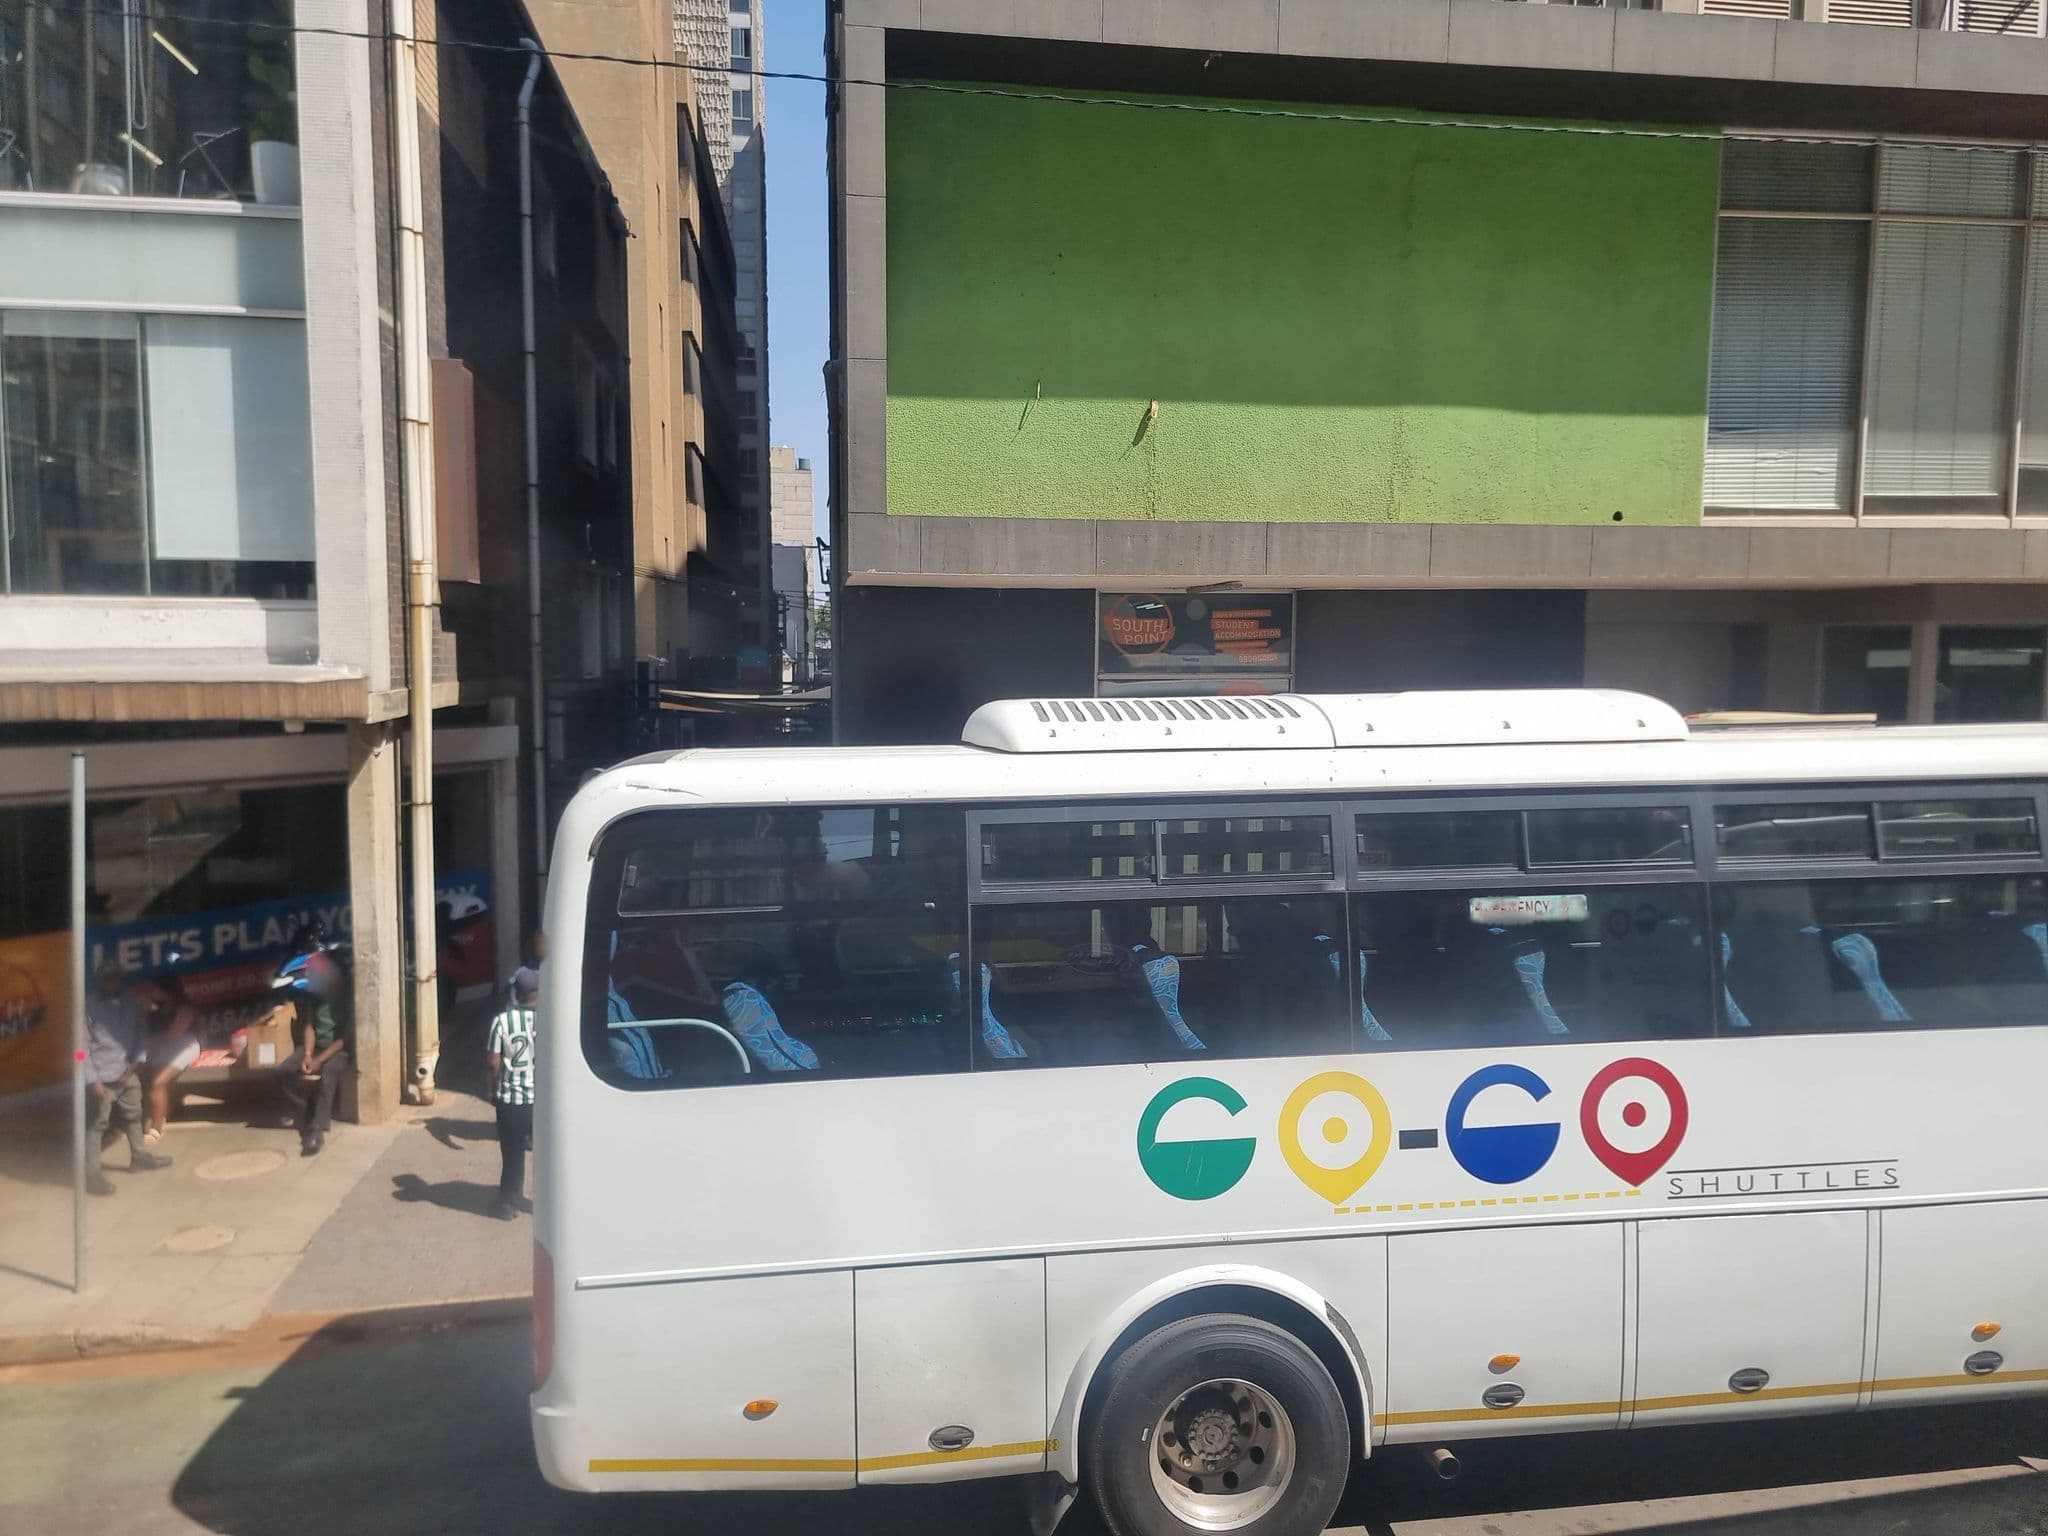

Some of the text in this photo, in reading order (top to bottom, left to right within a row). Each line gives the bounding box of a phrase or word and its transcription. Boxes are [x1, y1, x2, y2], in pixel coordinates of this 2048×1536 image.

[1112, 618, 1163, 632] SOUTH
[1215, 620, 1256, 629] STUDENT
[1125, 630, 1168, 645] POINT
[511, 1035, 535, 1067] 2
[1668, 1168, 1898, 1196] SHUTTLES
